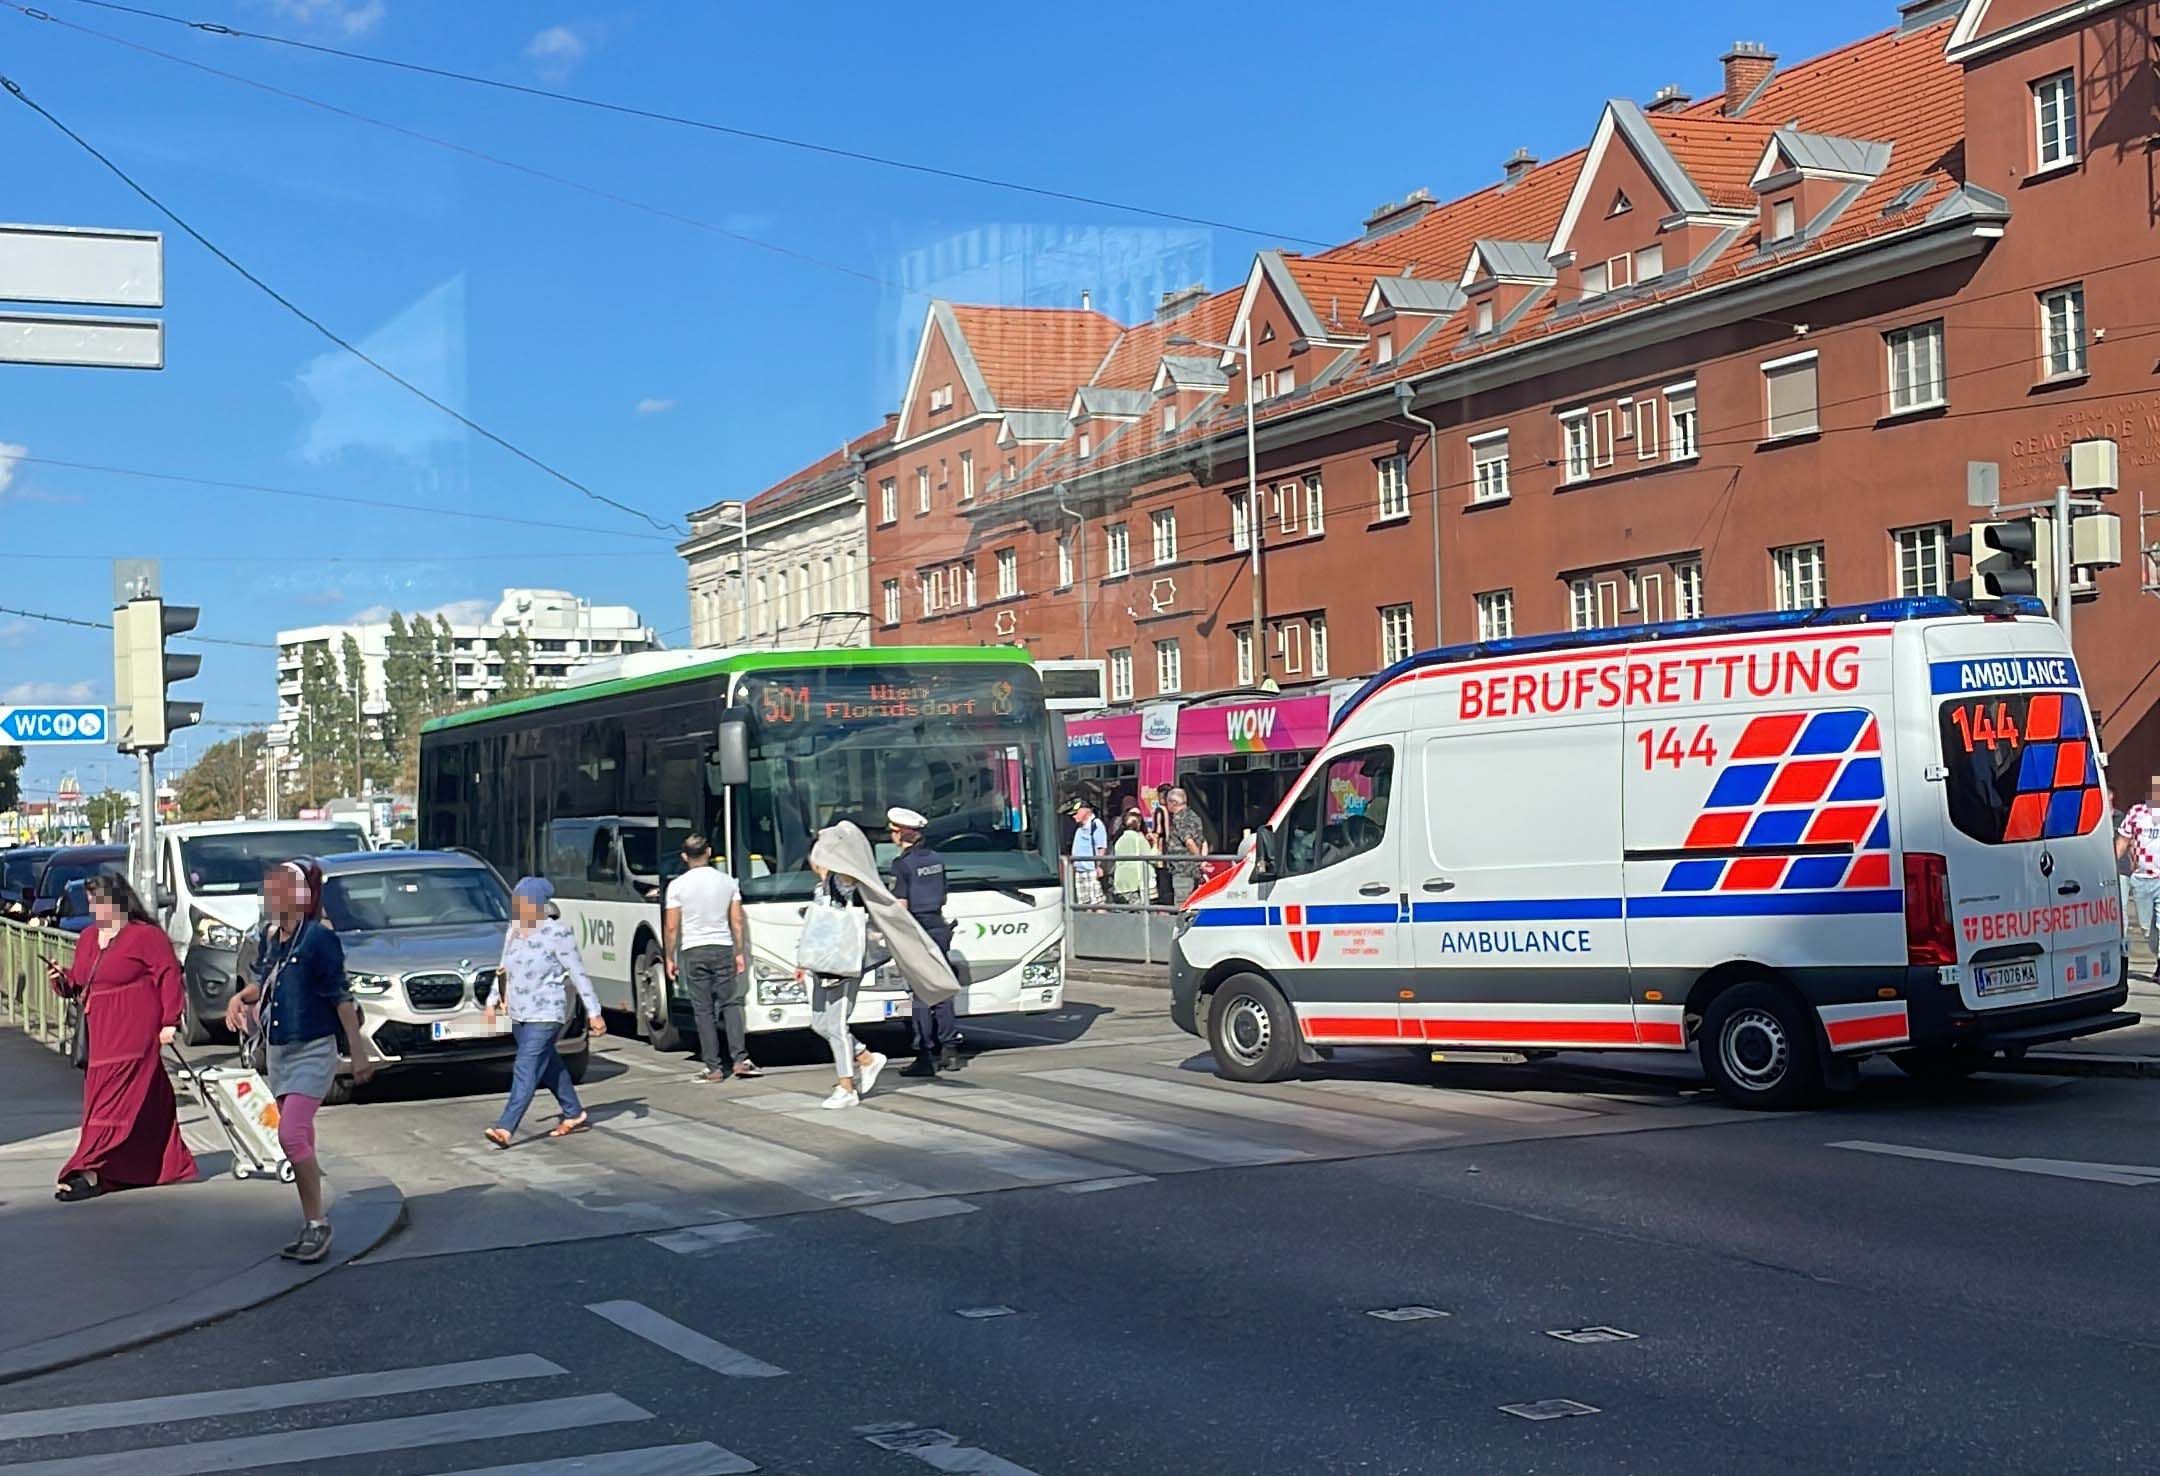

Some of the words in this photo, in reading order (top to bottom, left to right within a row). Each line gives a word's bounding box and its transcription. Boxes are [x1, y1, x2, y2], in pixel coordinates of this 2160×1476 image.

[1458, 645, 1861, 720] BERUFSRETTUNG
[1961, 660, 2068, 689] AMBULANCE
[762, 685, 810, 723] 501
[825, 698, 976, 719] Floridsdorf
[15, 714, 50, 737] WC
[1227, 706, 1277, 741] WOW
[1952, 702, 2019, 752] 144
[1637, 724, 1718, 770] 144
[916, 863, 943, 876] POLIZEI
[588, 918, 615, 947] VOR
[989, 922, 1030, 936] VOR
[1982, 896, 2118, 941] BERUFSRETTUNG
[1440, 929, 1592, 954] AMBULANCE
